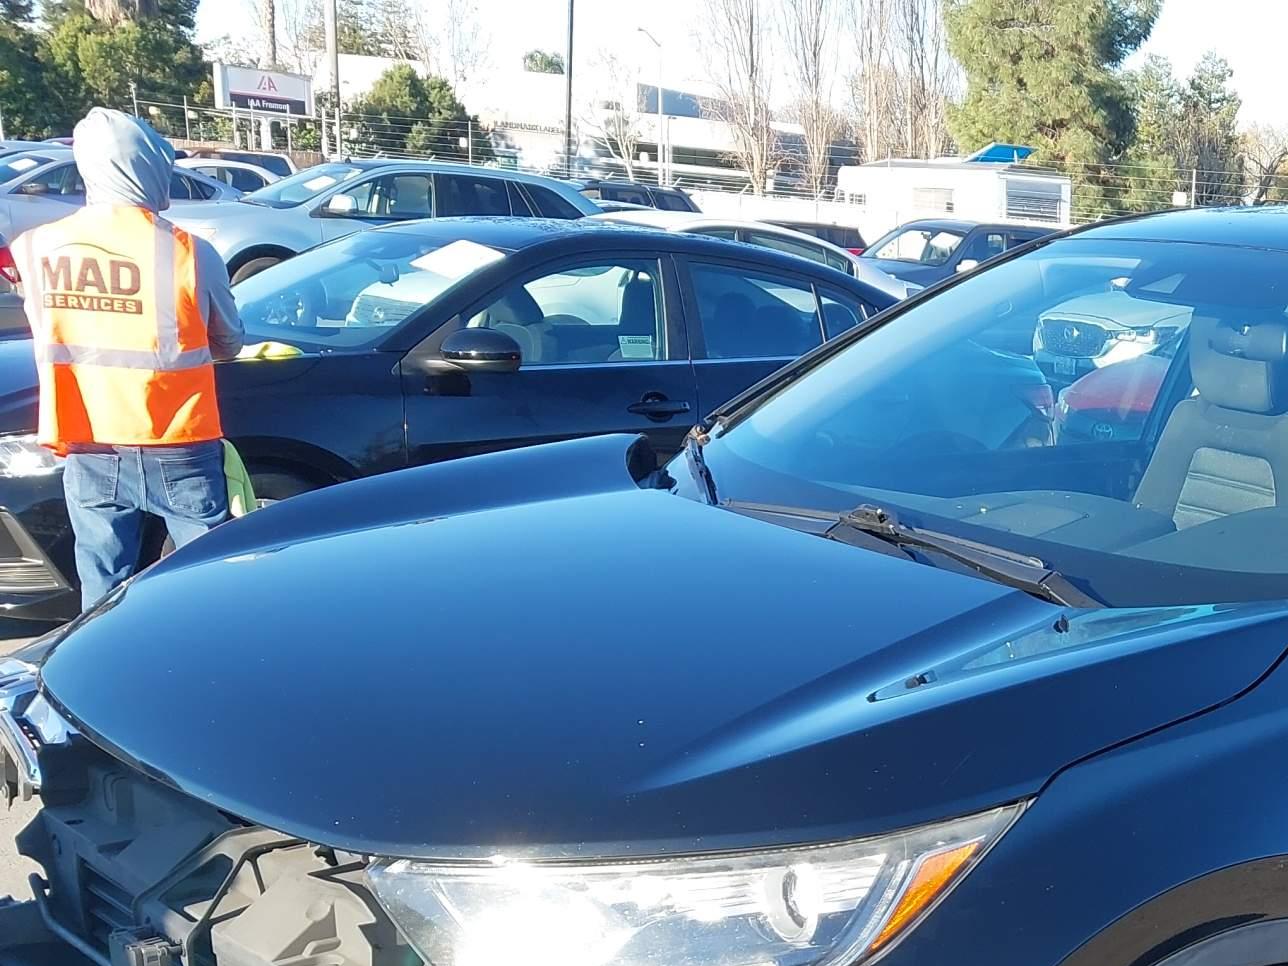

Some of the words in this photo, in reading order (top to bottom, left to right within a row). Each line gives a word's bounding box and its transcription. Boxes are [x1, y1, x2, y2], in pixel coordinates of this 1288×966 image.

[261, 100, 289, 110] Fremon
[41, 255, 141, 296] MAD
[44, 294, 138, 312] SERVICES
